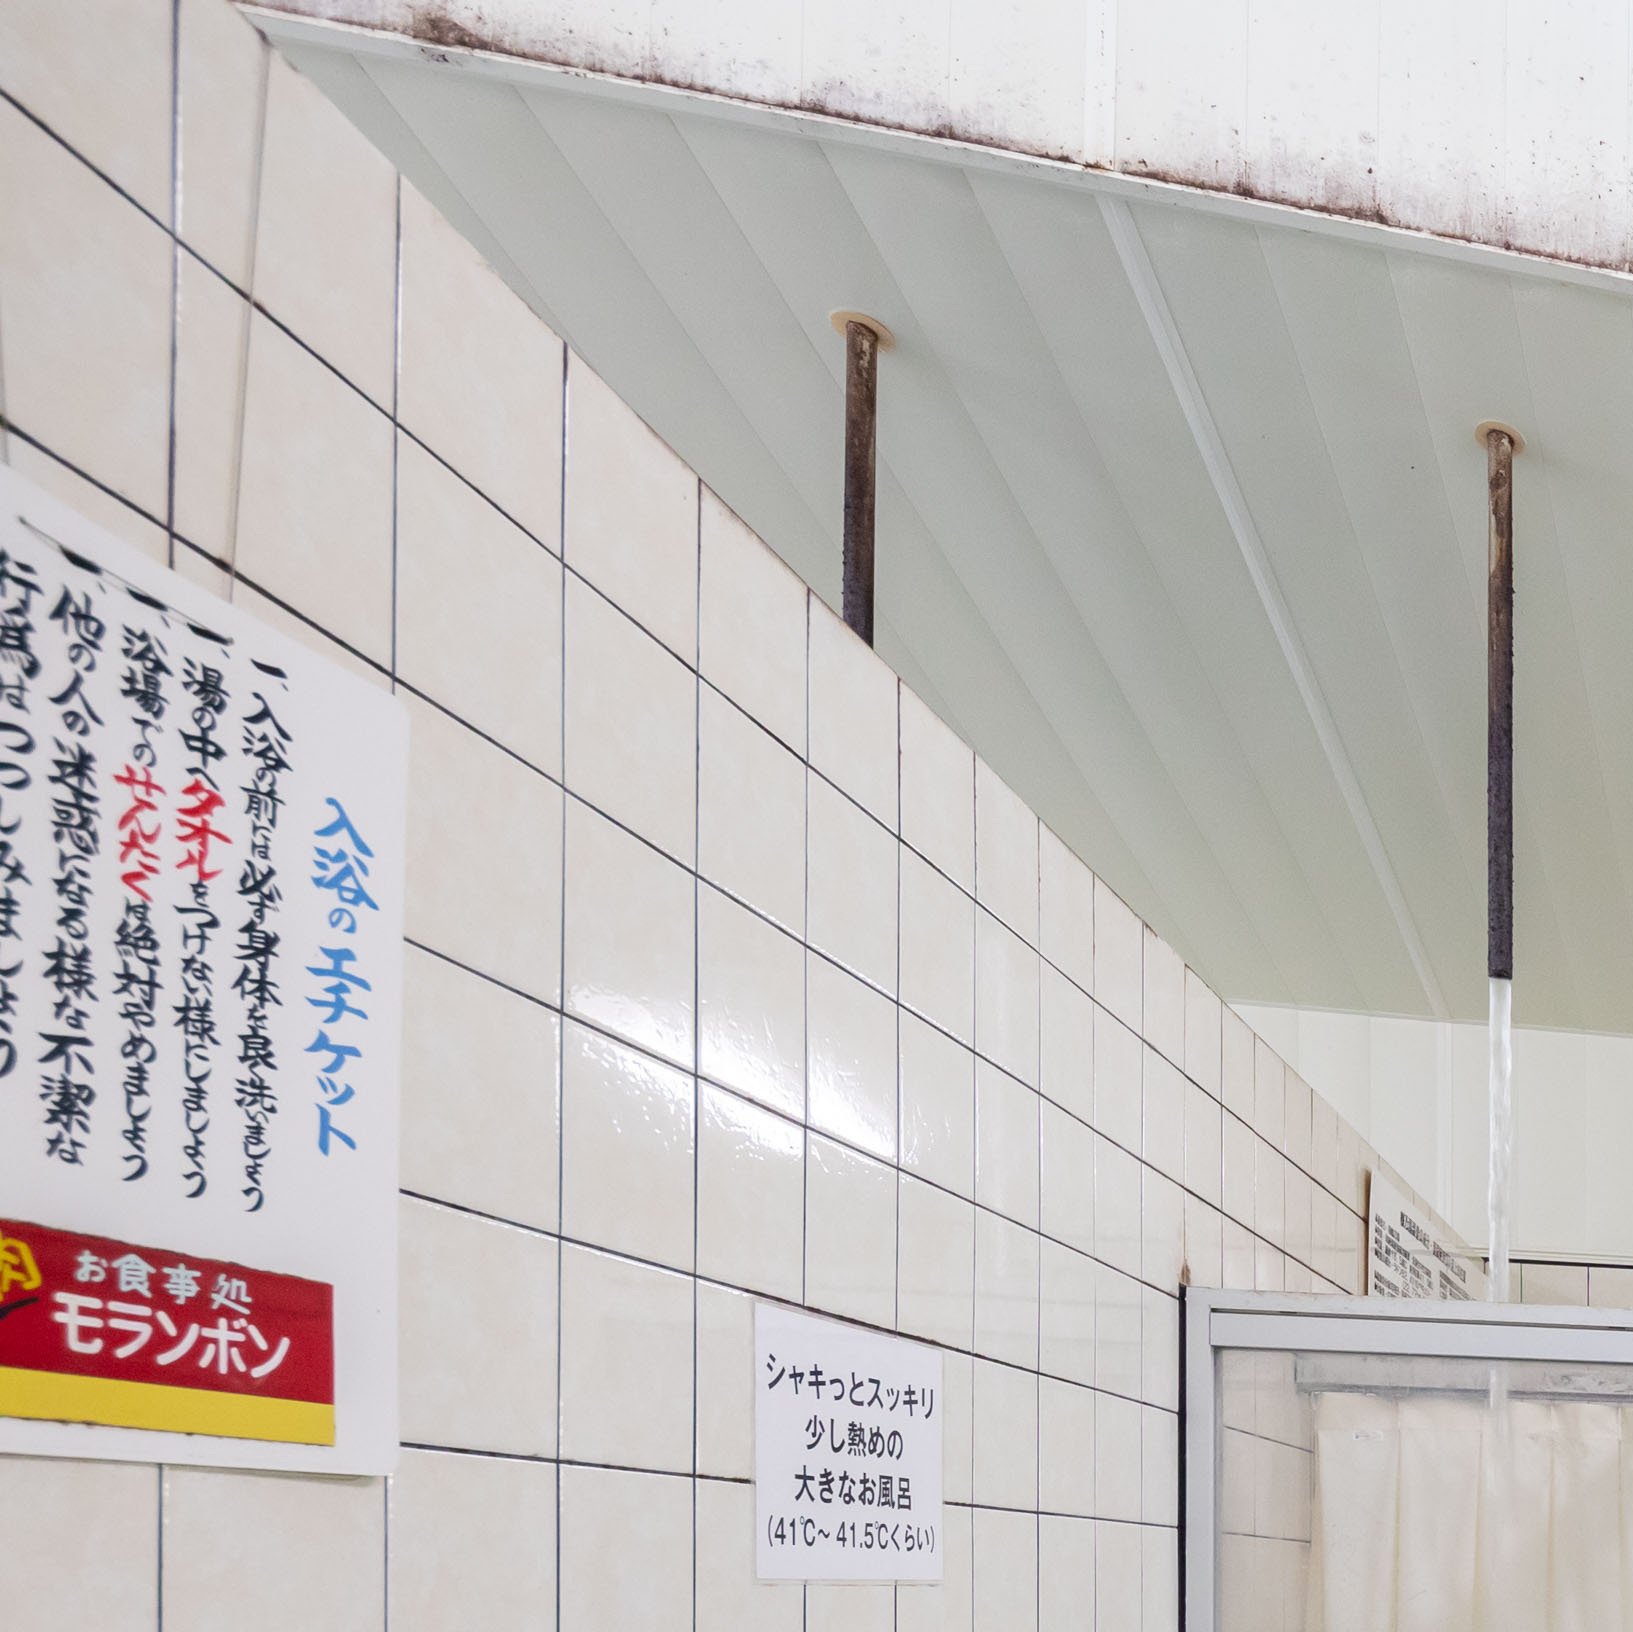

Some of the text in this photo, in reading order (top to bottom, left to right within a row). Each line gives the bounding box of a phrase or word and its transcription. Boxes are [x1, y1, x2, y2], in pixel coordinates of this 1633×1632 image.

[304, 796, 380, 1157] 入浴のエチケット
[74, 1249, 252, 1315] お食事処
[53, 1290, 291, 1378] モランボン
[766, 1353, 935, 1420] シャキっとスッキリ
[804, 1414, 904, 1461] 少し熱めの
[794, 1464, 913, 1511] 大きなお風呂
